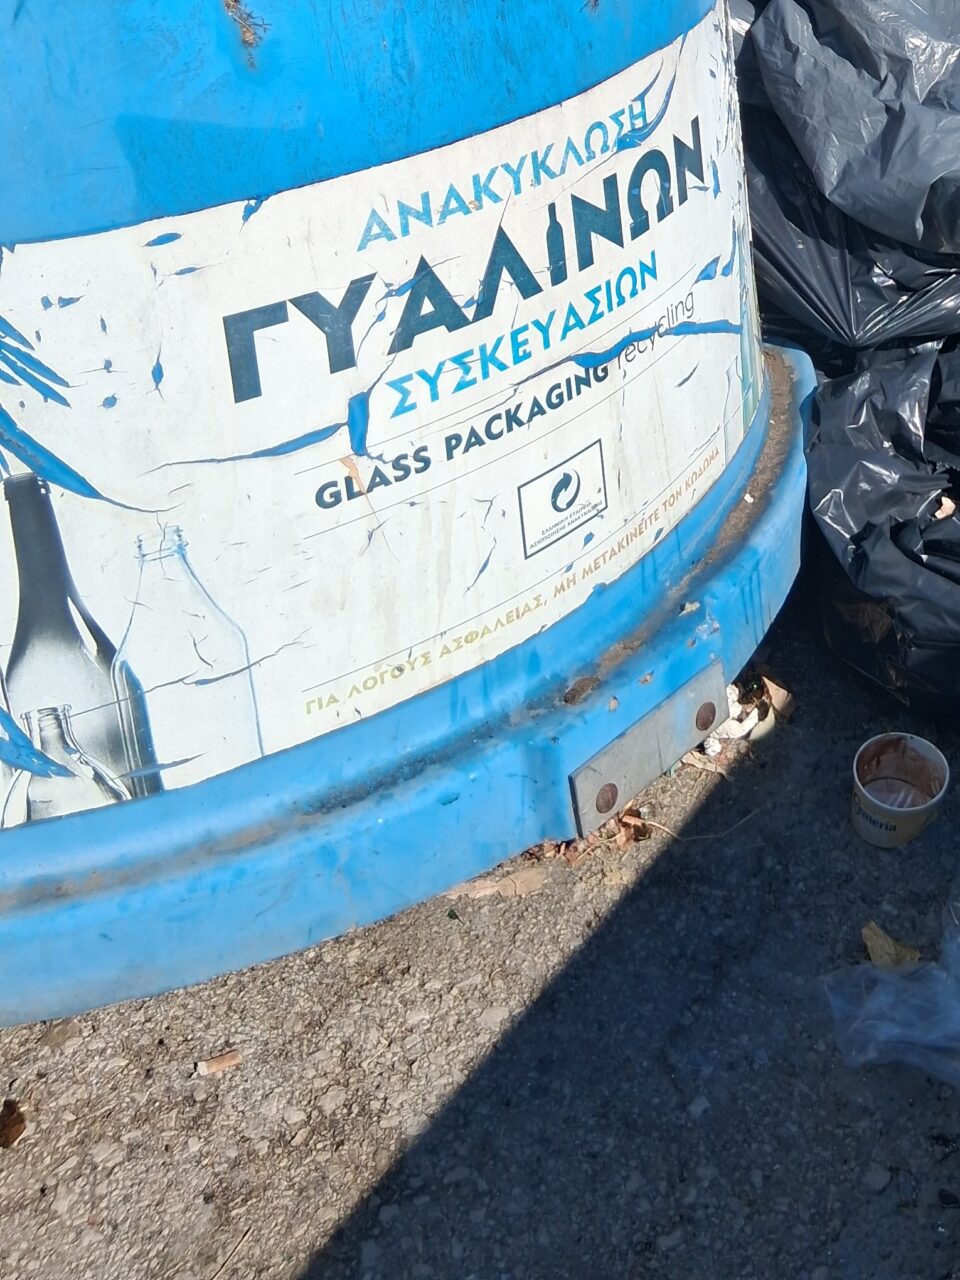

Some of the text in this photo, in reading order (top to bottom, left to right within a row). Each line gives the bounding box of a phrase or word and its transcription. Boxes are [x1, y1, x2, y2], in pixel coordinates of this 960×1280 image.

[222, 117, 708, 404] ΓΥΑΛΙΝΩΝ
[356, 93, 650, 252] ΑΝΑΚΥΚΛΩΣΗ
[315, 291, 695, 510] GLASS PACKAGING recycling
[384, 250, 658, 419] ΣΥΣΚΕΥΑΣΙΩΝ
[304, 445, 721, 716] ΓΙΑ ΛΟΓΟΥΣ ΑΣΦΑΛΕΙΑΣ, ΜΗ ΜΕΤΑΚΙΝΕΙΤΕ ΤΟΝ ΚΩΔΩΝΑ
